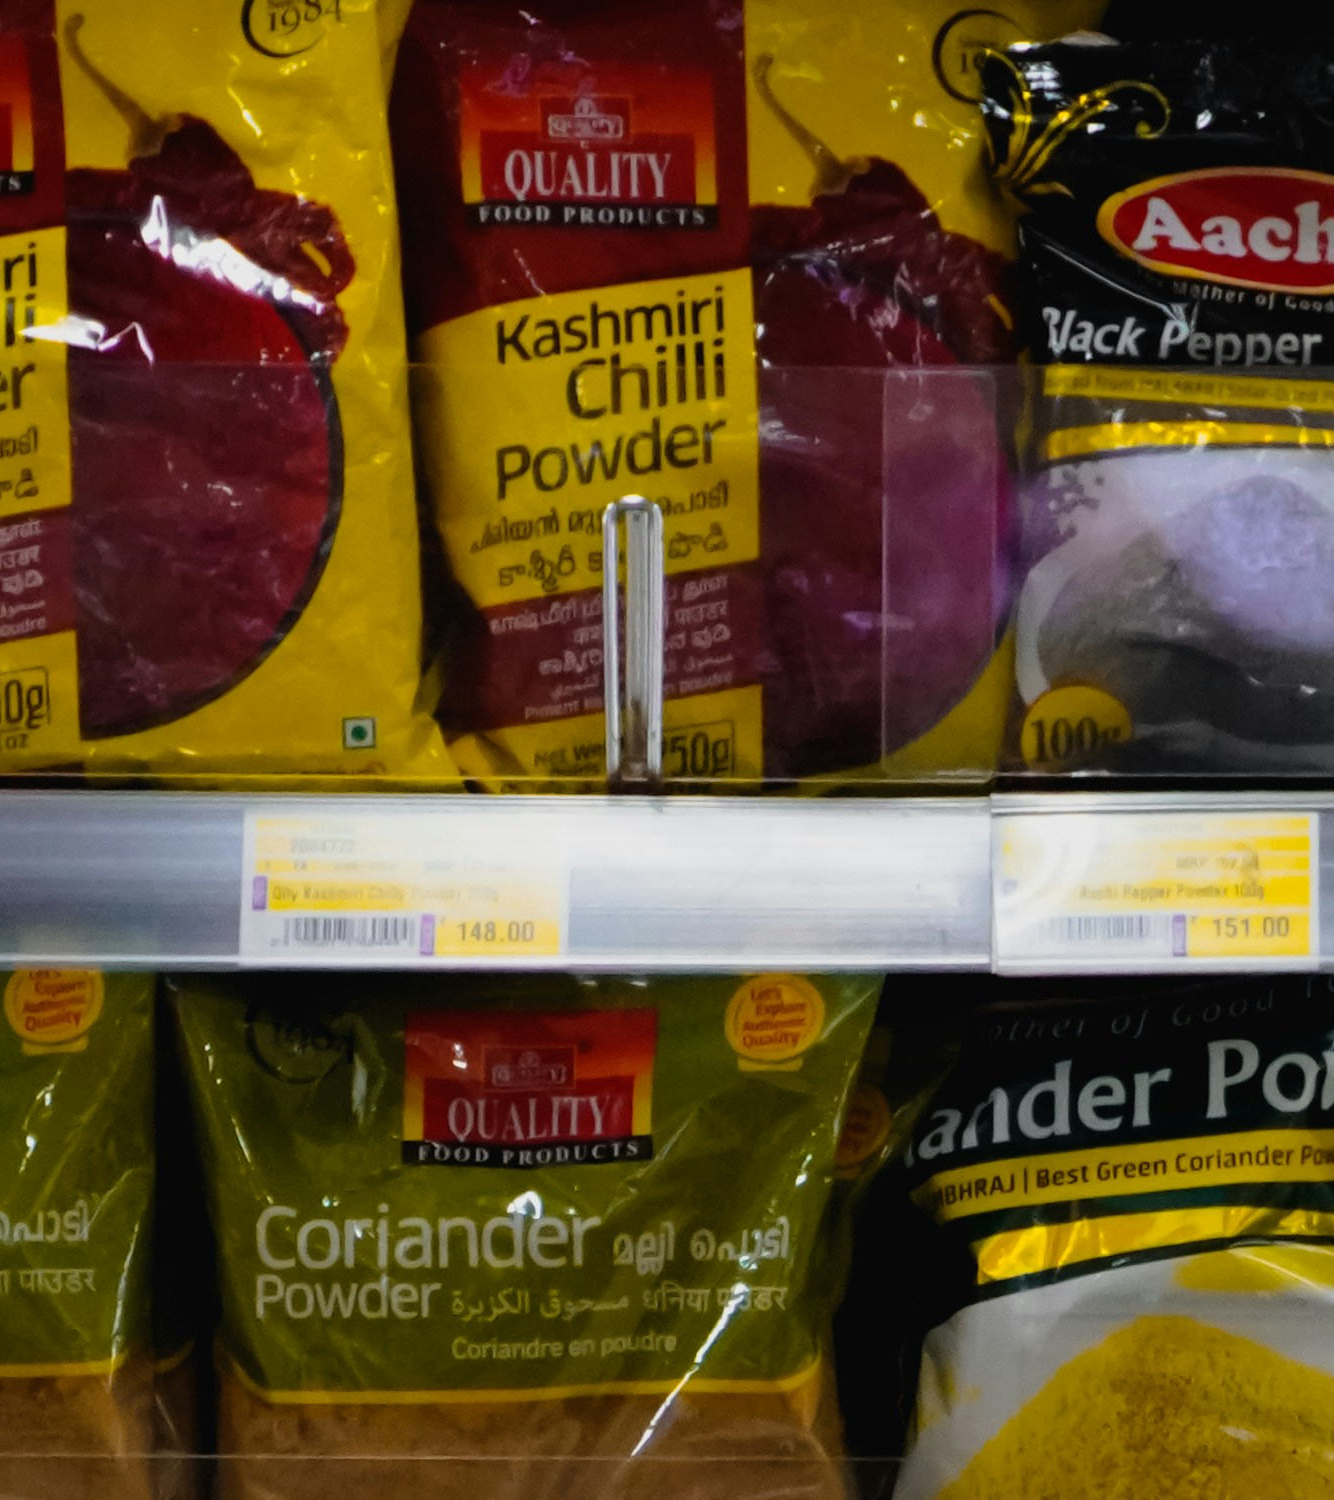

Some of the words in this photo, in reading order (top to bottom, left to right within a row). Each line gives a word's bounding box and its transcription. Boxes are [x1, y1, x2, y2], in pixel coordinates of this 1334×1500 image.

[503, 152, 671, 200] QUALITY
[478, 205, 553, 226] FOOD
[563, 205, 708, 228] PRODUCTS
[496, 288, 726, 364] Kashmiri
[1158, 316, 1323, 368] Pepper
[567, 339, 728, 420] Chilli
[495, 416, 728, 500] Powder
[455, 921, 536, 944] 148.00
[1210, 917, 1291, 942] 151.00
[448, 1094, 611, 1142] QUALITY
[418, 1142, 492, 1165] FOOD
[502, 1138, 641, 1166] PRODUCTS
[1035, 1165, 1091, 1190] Best
[1095, 1158, 1168, 1183] Green
[1174, 1145, 1294, 1174] Coriander
[255, 1203, 604, 1271] Coriander
[255, 1272, 442, 1321] Powder
[452, 1335, 564, 1362] Coriandre
[568, 1339, 595, 1359] en
[602, 1329, 677, 1362] poudre
